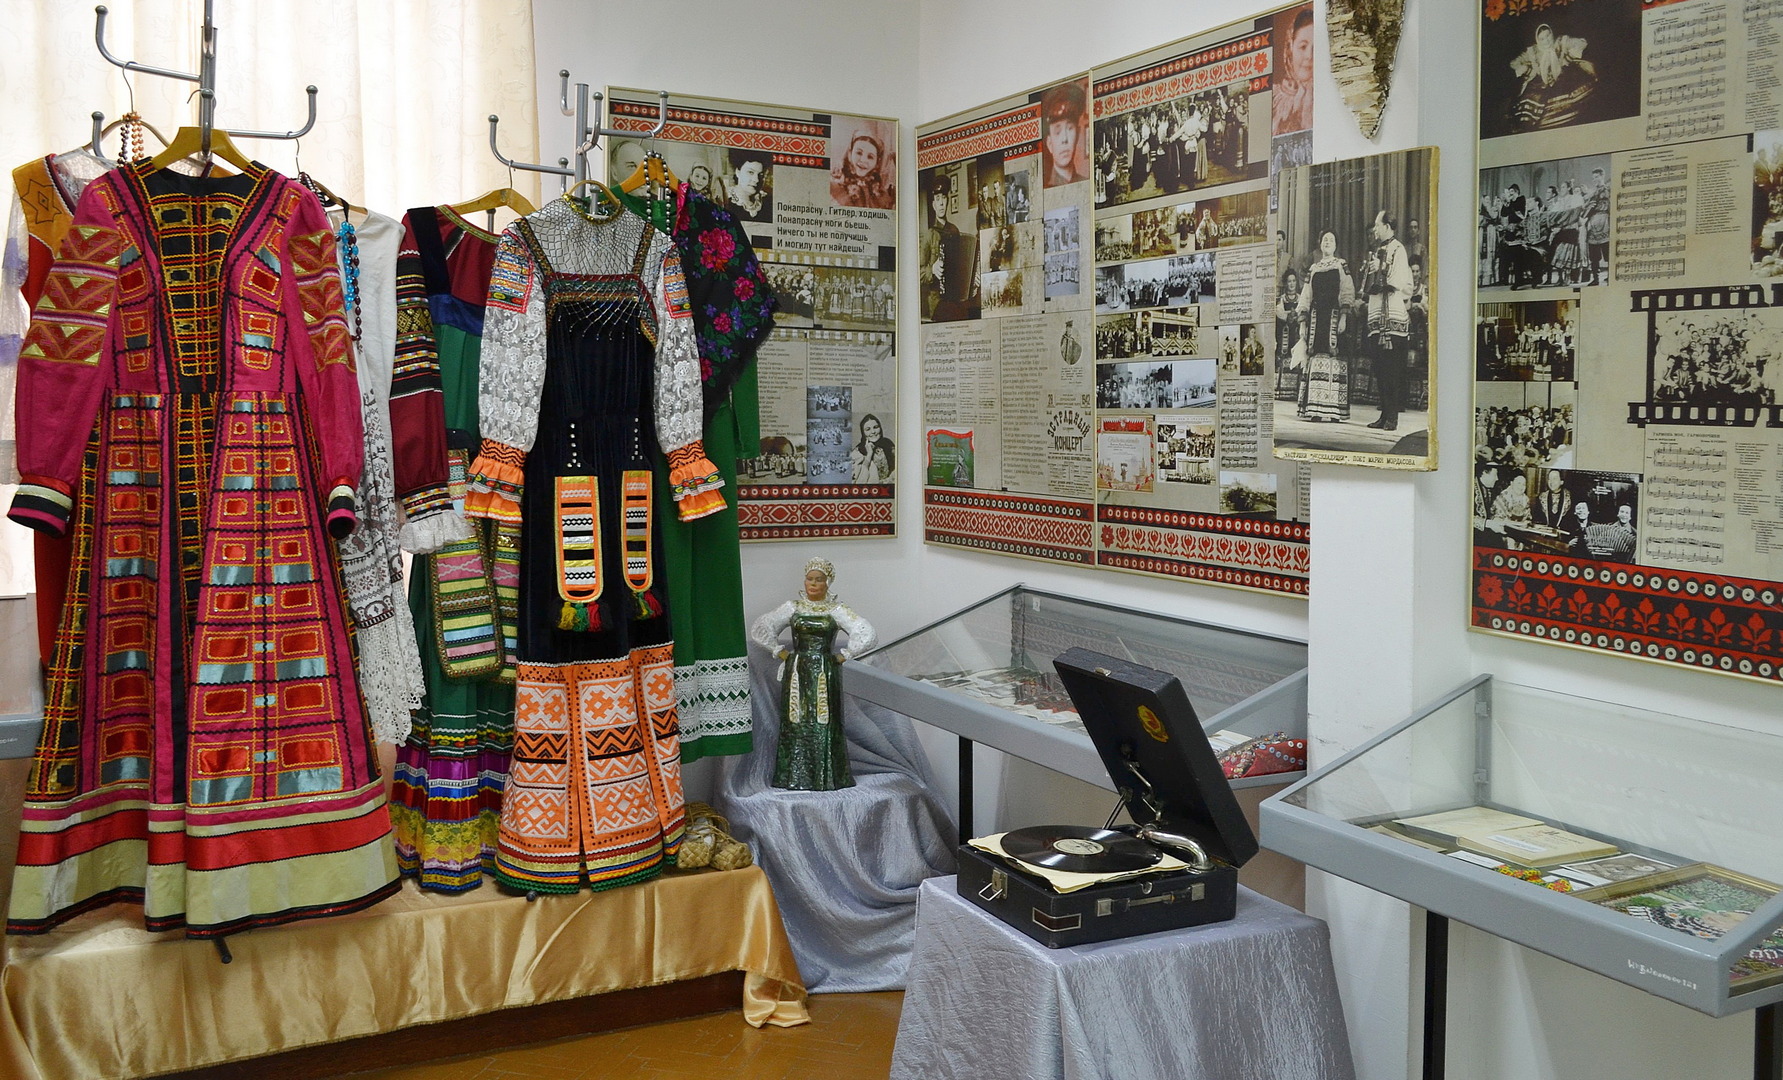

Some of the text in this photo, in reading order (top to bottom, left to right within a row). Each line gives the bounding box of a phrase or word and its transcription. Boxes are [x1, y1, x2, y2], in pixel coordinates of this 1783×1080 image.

[777, 202, 823, 215] Понапрасну
[777, 214, 823, 228] Понапрасну
[825, 220, 843, 228] ноги
[777, 227, 868, 243] Ничего ты не получишь
[777, 239, 865, 253] И могилу тут найдешь!
[1047, 409, 1091, 438] ЭСТРАДНЫЙ
[1054, 435, 1083, 452] КОНЦЕРТ
[1386, 457, 1415, 466] МОРДАСОВА
